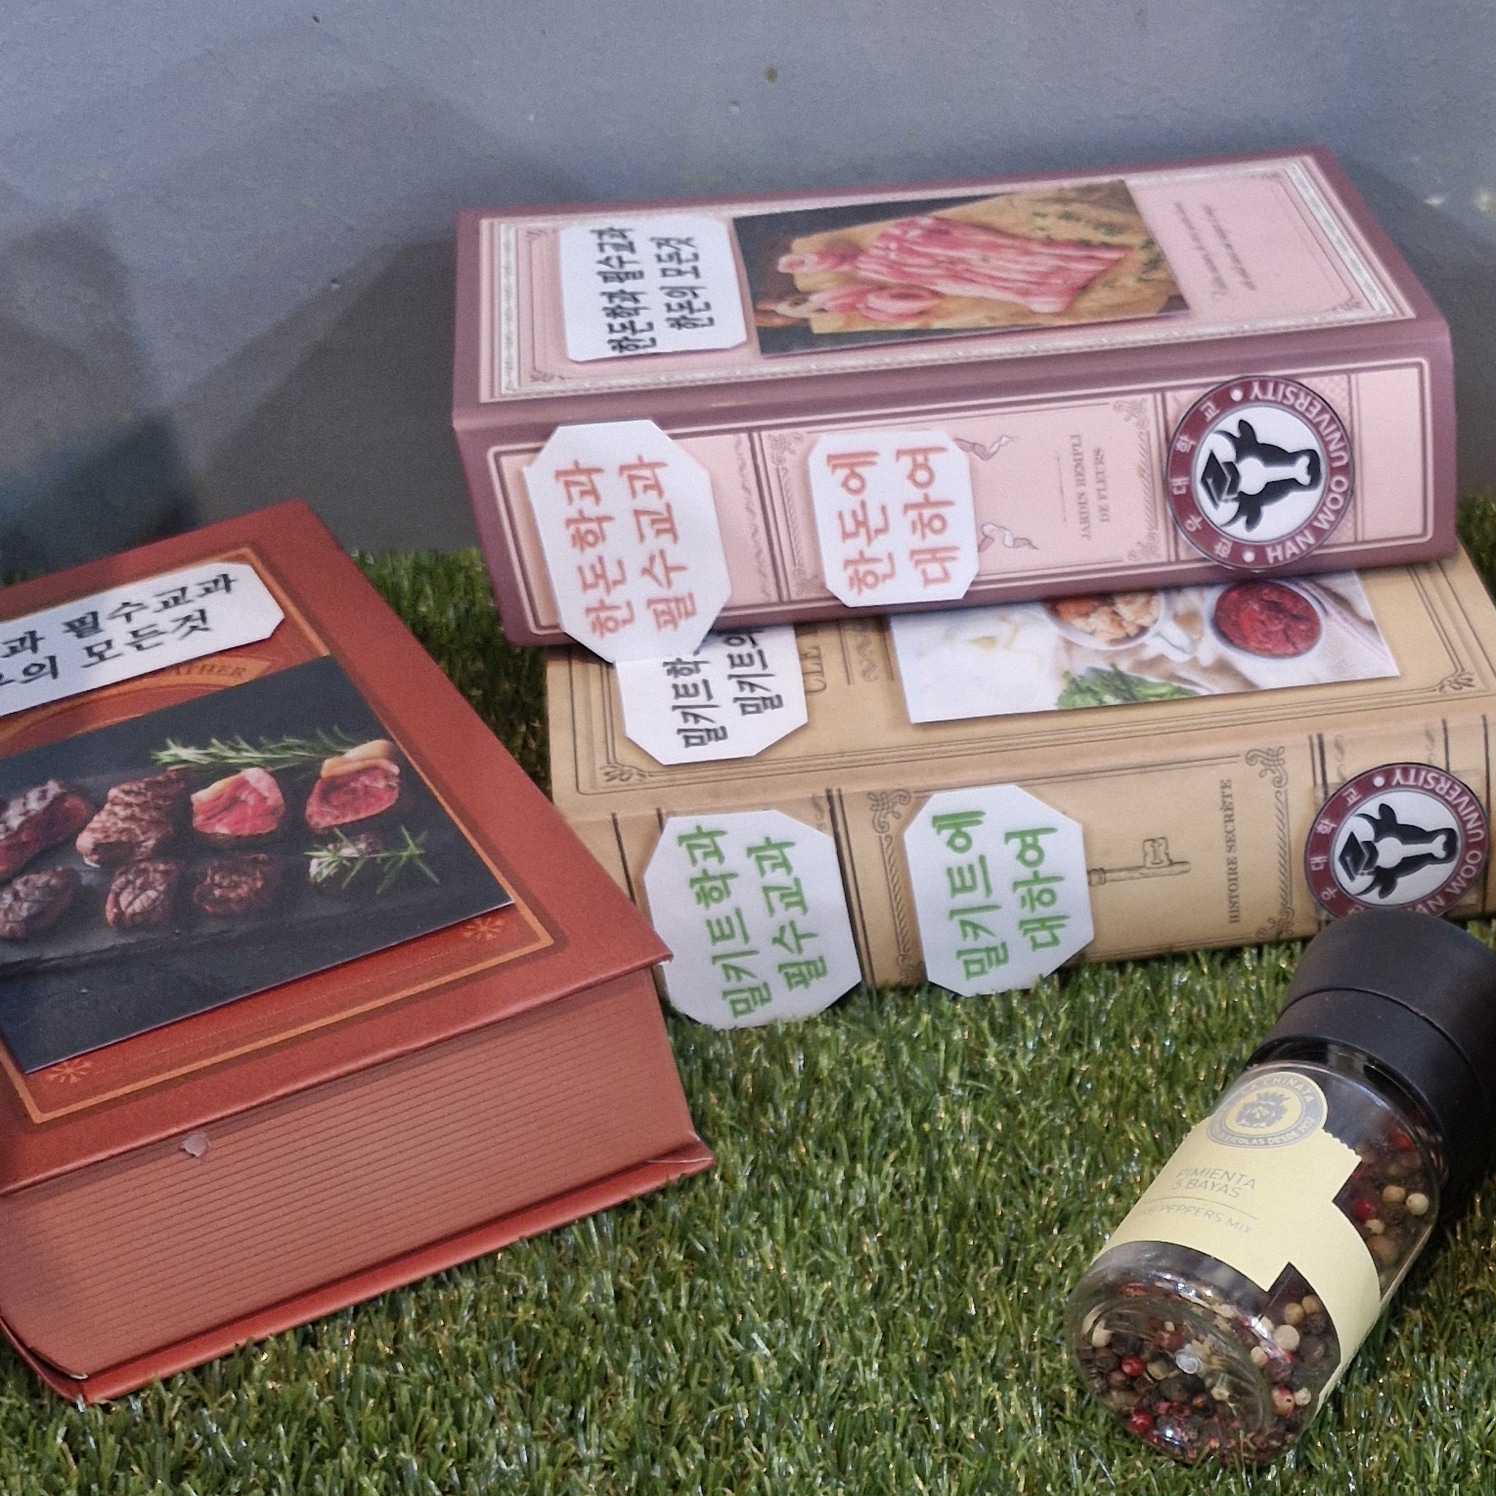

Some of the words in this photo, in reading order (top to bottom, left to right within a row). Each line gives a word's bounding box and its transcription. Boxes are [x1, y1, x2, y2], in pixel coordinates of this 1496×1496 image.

[590, 226, 645, 284] 필수교과
[649, 236, 702, 280] 모든것
[601, 288, 659, 355] 한돈학과
[664, 285, 716, 331] 한돈의
[1250, 381, 1349, 468] UNIVERSITY
[825, 449, 897, 596] 한돈에
[894, 445, 960, 588] 대하여
[1098, 505, 1111, 523] DE
[1312, 475, 1349, 531] WOO
[554, 459, 635, 639] 한돈학과
[617, 454, 697, 631] 필수교과
[1264, 530, 1316, 564] HAN
[62, 572, 239, 640] 필수교과
[80, 608, 211, 672] 모든것
[663, 651, 729, 749] 밀키트학
[1219, 778, 1237, 853] SECRÈTE
[1391, 768, 1484, 843] UNIVERSITY
[931, 810, 1011, 981] 밀키트에
[1004, 826, 1073, 954] 대하여
[1226, 856, 1241, 924] HISTOIRE
[1446, 849, 1483, 896] WOO
[677, 824, 774, 1020] 밀키트학과
[746, 836, 829, 992] 필수교과
[1263, 1077, 1315, 1103] CHINATA
[1176, 1167, 1257, 1190] PIMIENTA
[1185, 1178, 1242, 1198] BAYAS
[1160, 1204, 1224, 1222] PEPPERS
[1225, 1218, 1253, 1235] MIX
